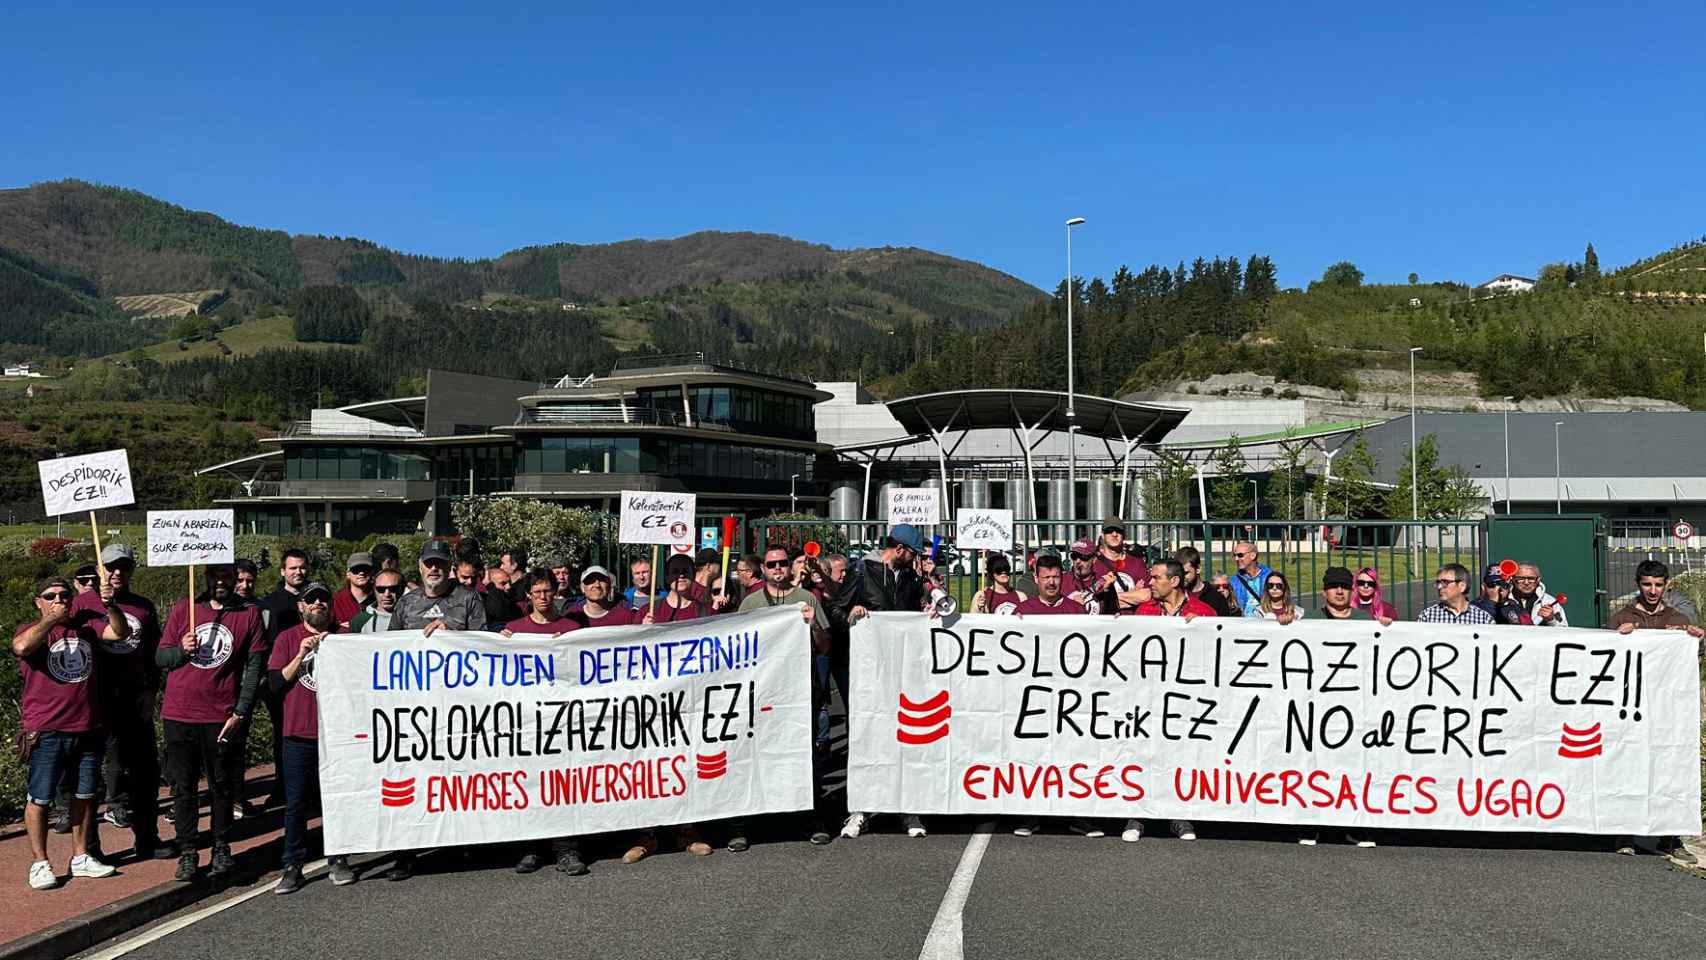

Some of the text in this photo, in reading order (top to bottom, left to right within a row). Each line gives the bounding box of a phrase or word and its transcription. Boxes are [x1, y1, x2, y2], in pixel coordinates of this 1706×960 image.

[48, 463, 127, 493] DESPIDORIK
[73, 486, 108, 502] EZ!!
[152, 542, 228, 553] GURE BORROKA
[641, 514, 668, 529] EZ
[372, 631, 759, 691] LANPOSTUEN DEFENTZAN!!!
[931, 625, 1643, 722] DESLOKALIZAZIORIK EZ!!
[372, 680, 755, 764] DESLOKALIZAZIORIK EZ!
[1014, 684, 1151, 740] ERErik
[1163, 692, 1217, 741] EZ
[1285, 699, 1354, 754] NO
[1361, 710, 1395, 749] al
[1405, 705, 1508, 759] ERE
[426, 754, 687, 813] ENVASES UNIVERSALES
[964, 760, 1565, 820] ENVASES UNIVERSALES UGAO
